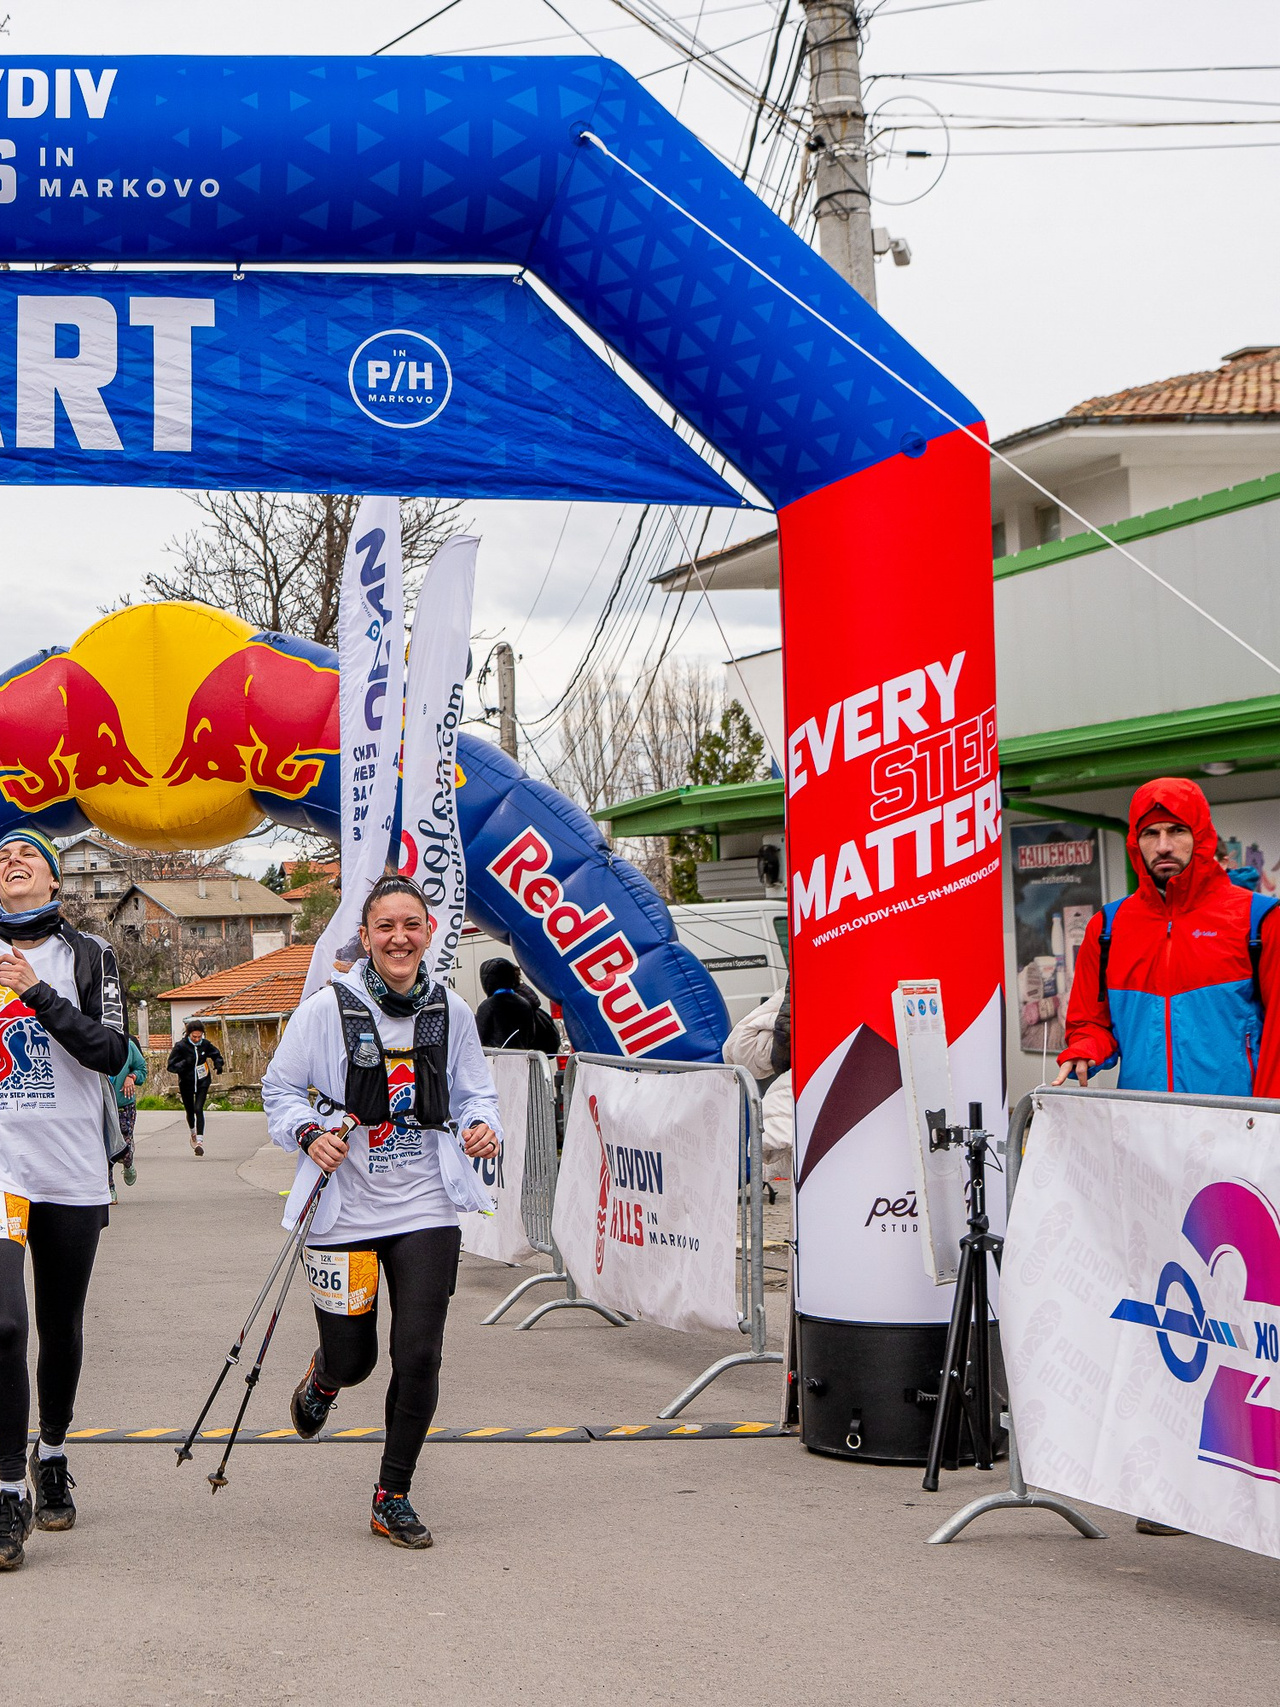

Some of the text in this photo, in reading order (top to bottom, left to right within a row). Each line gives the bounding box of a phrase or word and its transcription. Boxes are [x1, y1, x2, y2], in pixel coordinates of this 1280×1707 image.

[39, 147, 75, 167] IN
[39, 178, 222, 198] MARKOVO
[393, 349, 406, 357] IN
[367, 360, 434, 392] P/H
[368, 394, 434, 404] MARKOVO
[788, 650, 966, 800] EVERY
[870, 704, 998, 822] STEP
[486, 824, 616, 958] Red
[812, 857, 1000, 948] WWW.PLOVDIV-HILLS-IN-MARKOVO.COM
[568, 930, 687, 1059] Bull
[646, 1211, 658, 1226] IN
[881, 1223, 918, 1233] STUD
[649, 1231, 700, 1252] MARKOVO
